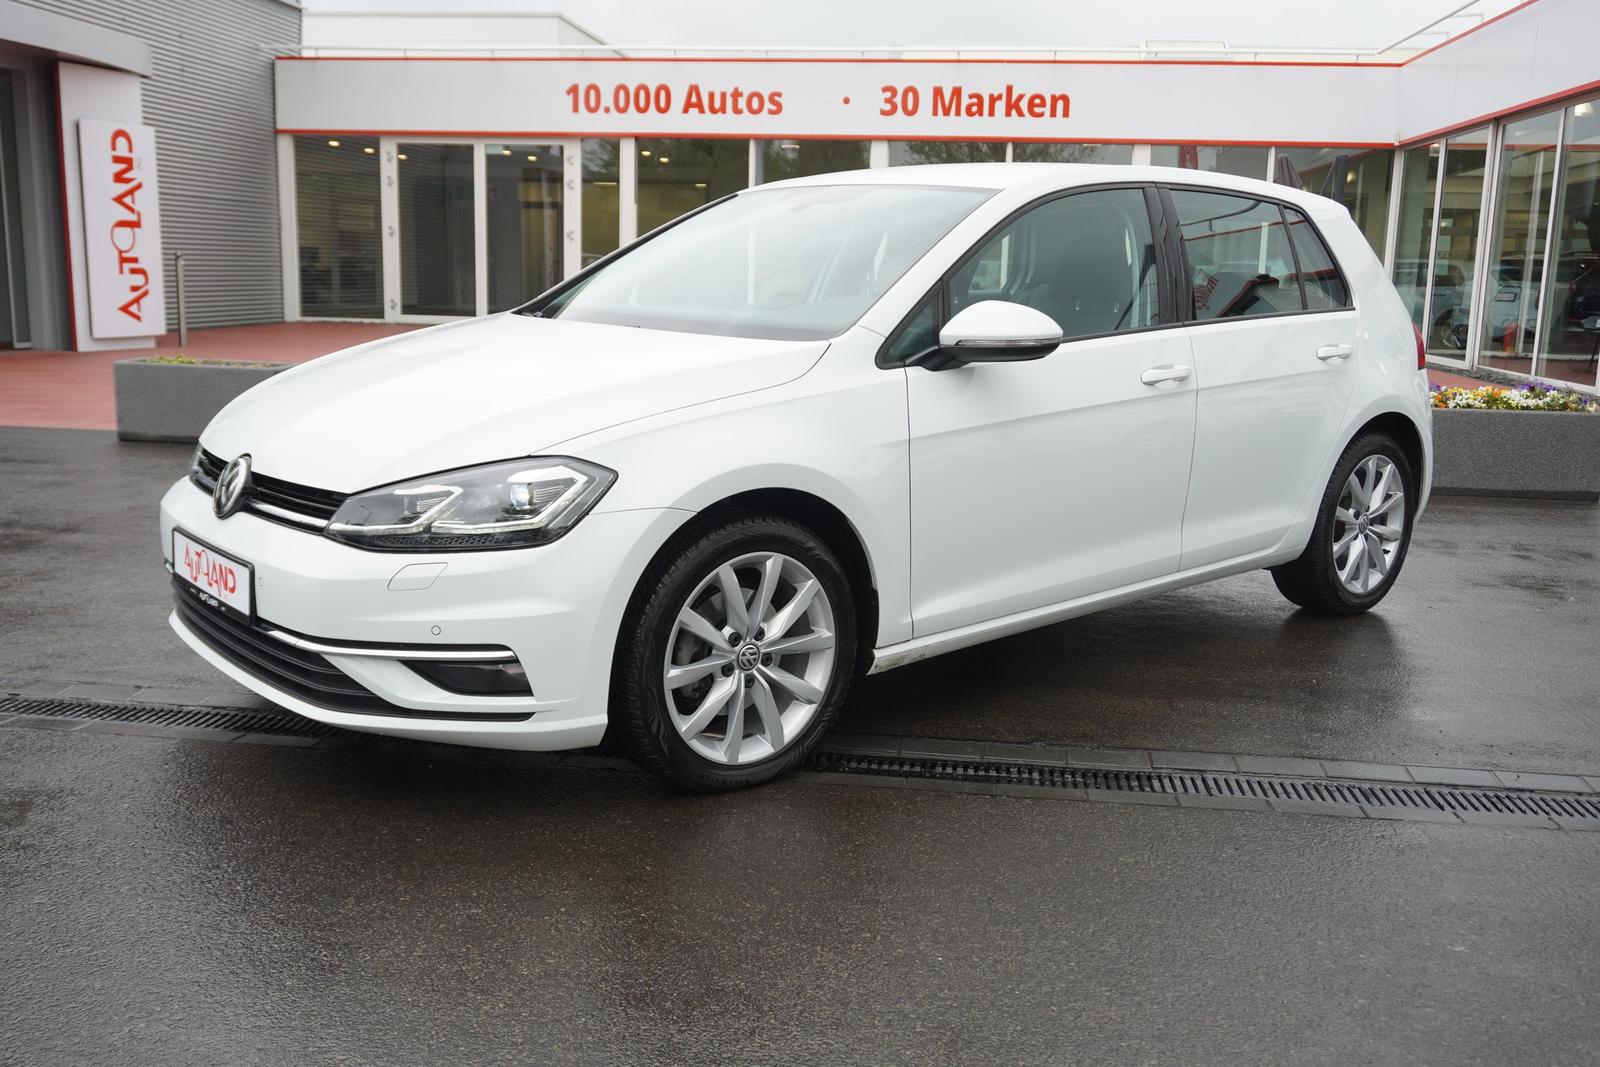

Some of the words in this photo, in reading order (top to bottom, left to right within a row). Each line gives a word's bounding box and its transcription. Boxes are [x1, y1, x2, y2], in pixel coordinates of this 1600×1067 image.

[565, 83, 673, 115] 10.000
[682, 83, 784, 116] Autos
[880, 85, 920, 117] 30
[931, 84, 1071, 118] Marken
[110, 128, 150, 323] AUTOLAND
[184, 543, 237, 597] AUTOLAND
